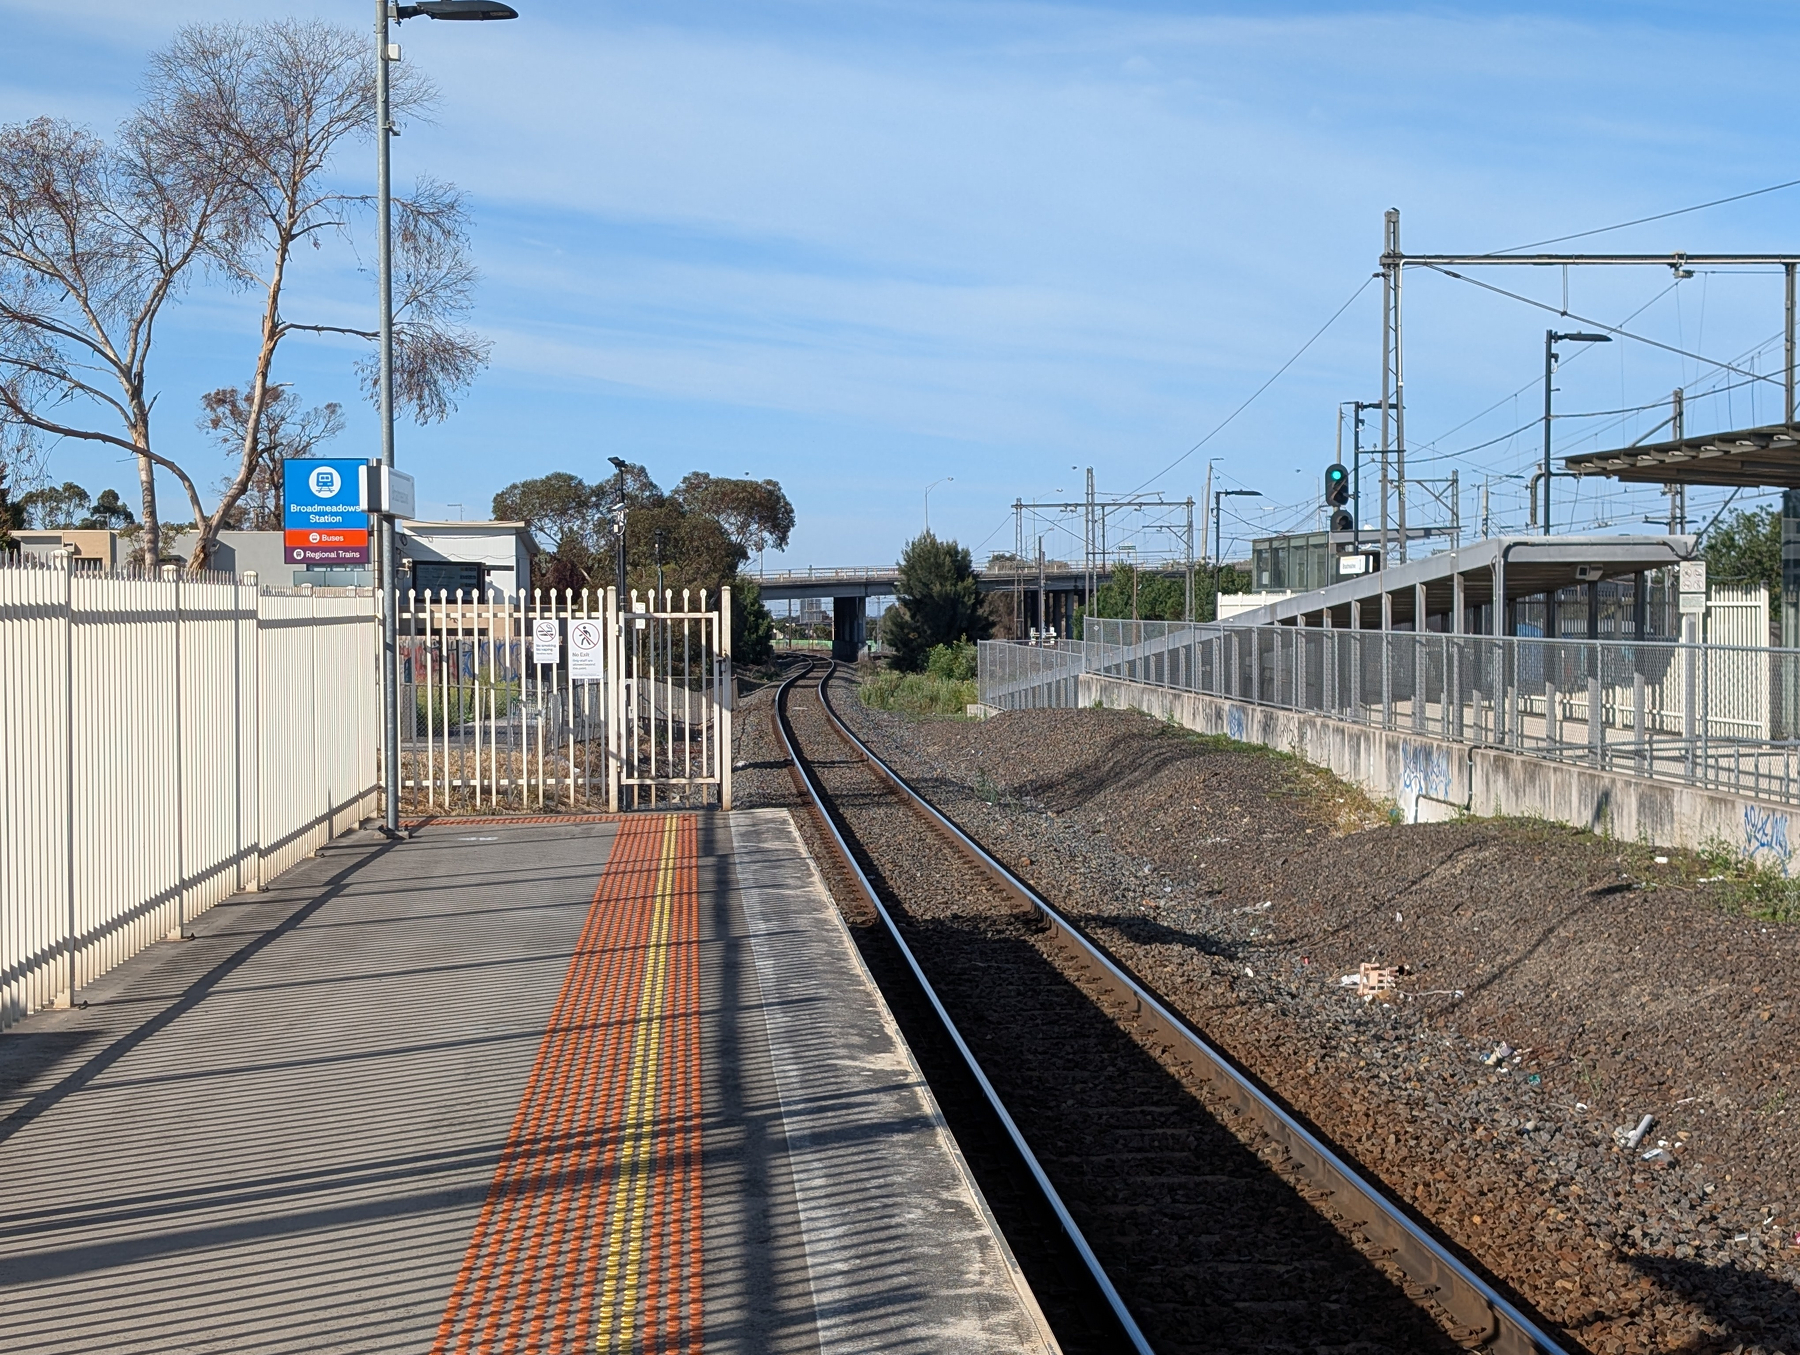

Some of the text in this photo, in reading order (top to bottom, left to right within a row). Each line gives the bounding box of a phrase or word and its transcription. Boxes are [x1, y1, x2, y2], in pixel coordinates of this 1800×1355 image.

[290, 504, 361, 512] Broadmeadows
[310, 514, 342, 523] Station
[306, 551, 337, 559] Regional
